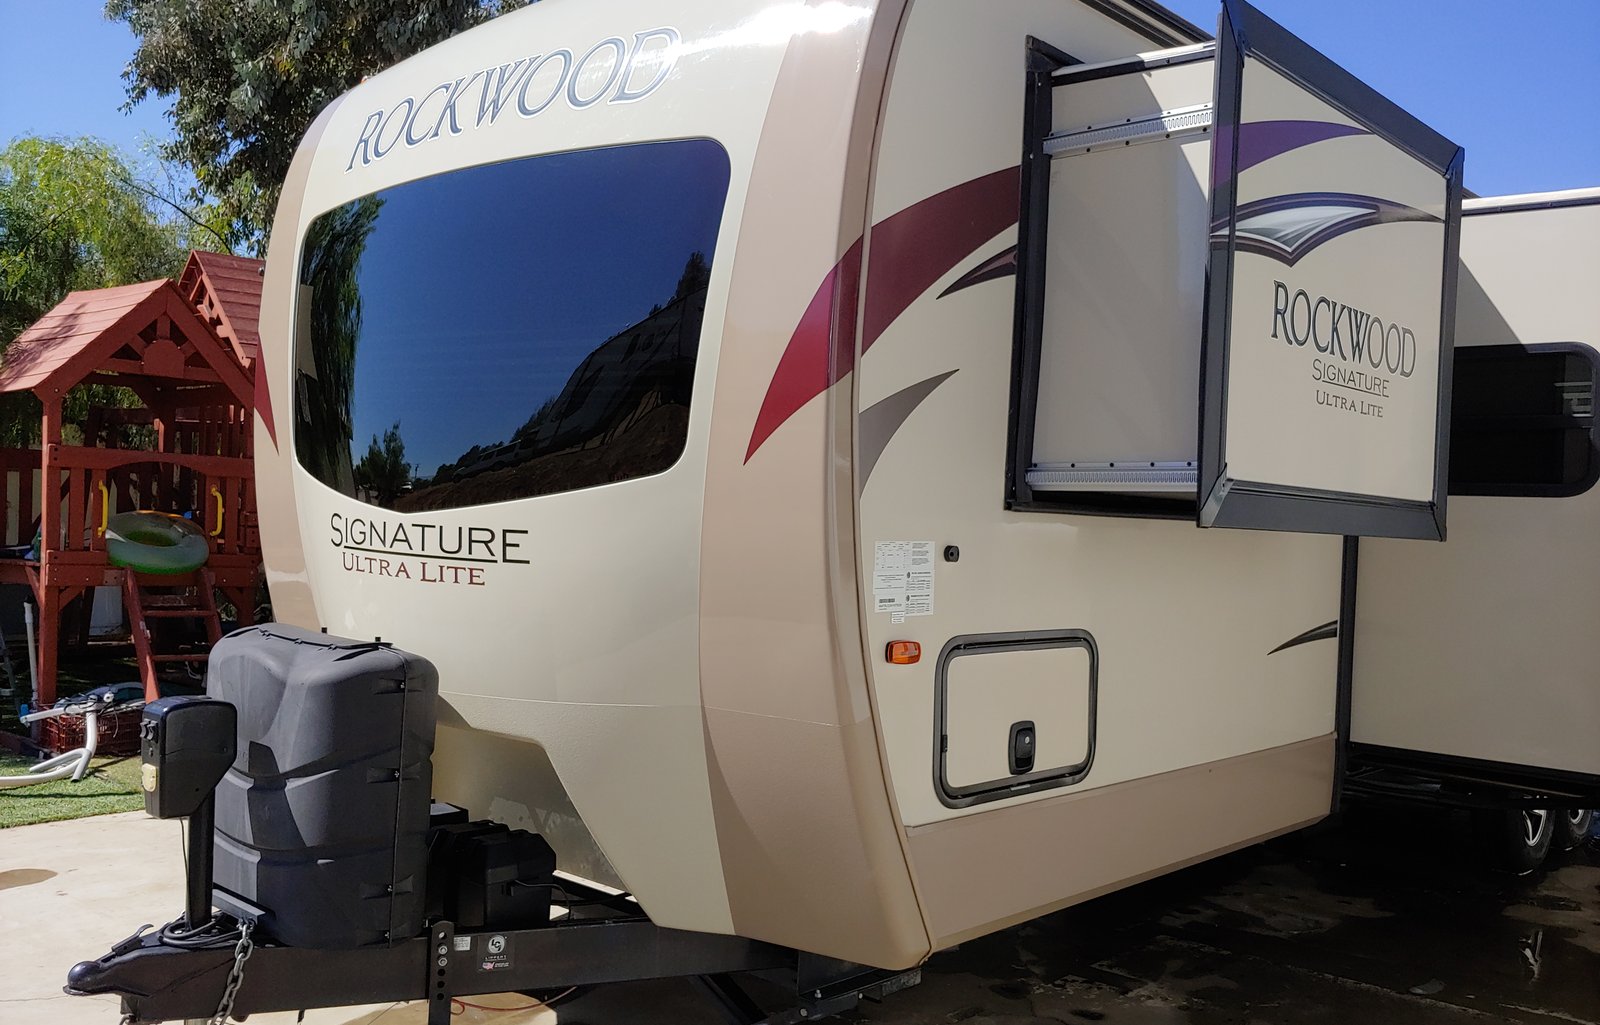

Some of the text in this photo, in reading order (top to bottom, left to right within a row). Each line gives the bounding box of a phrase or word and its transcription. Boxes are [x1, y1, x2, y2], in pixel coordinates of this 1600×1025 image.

[344, 28, 682, 173] ROCKWOOD
[1271, 279, 1416, 378] ROCKWOOD
[1312, 358, 1390, 398] SIGNATURE
[1316, 390, 1384, 418] ULTRA LITE
[330, 512, 530, 565] SIGNATURE
[341, 551, 486, 586] ULTRA LITE
